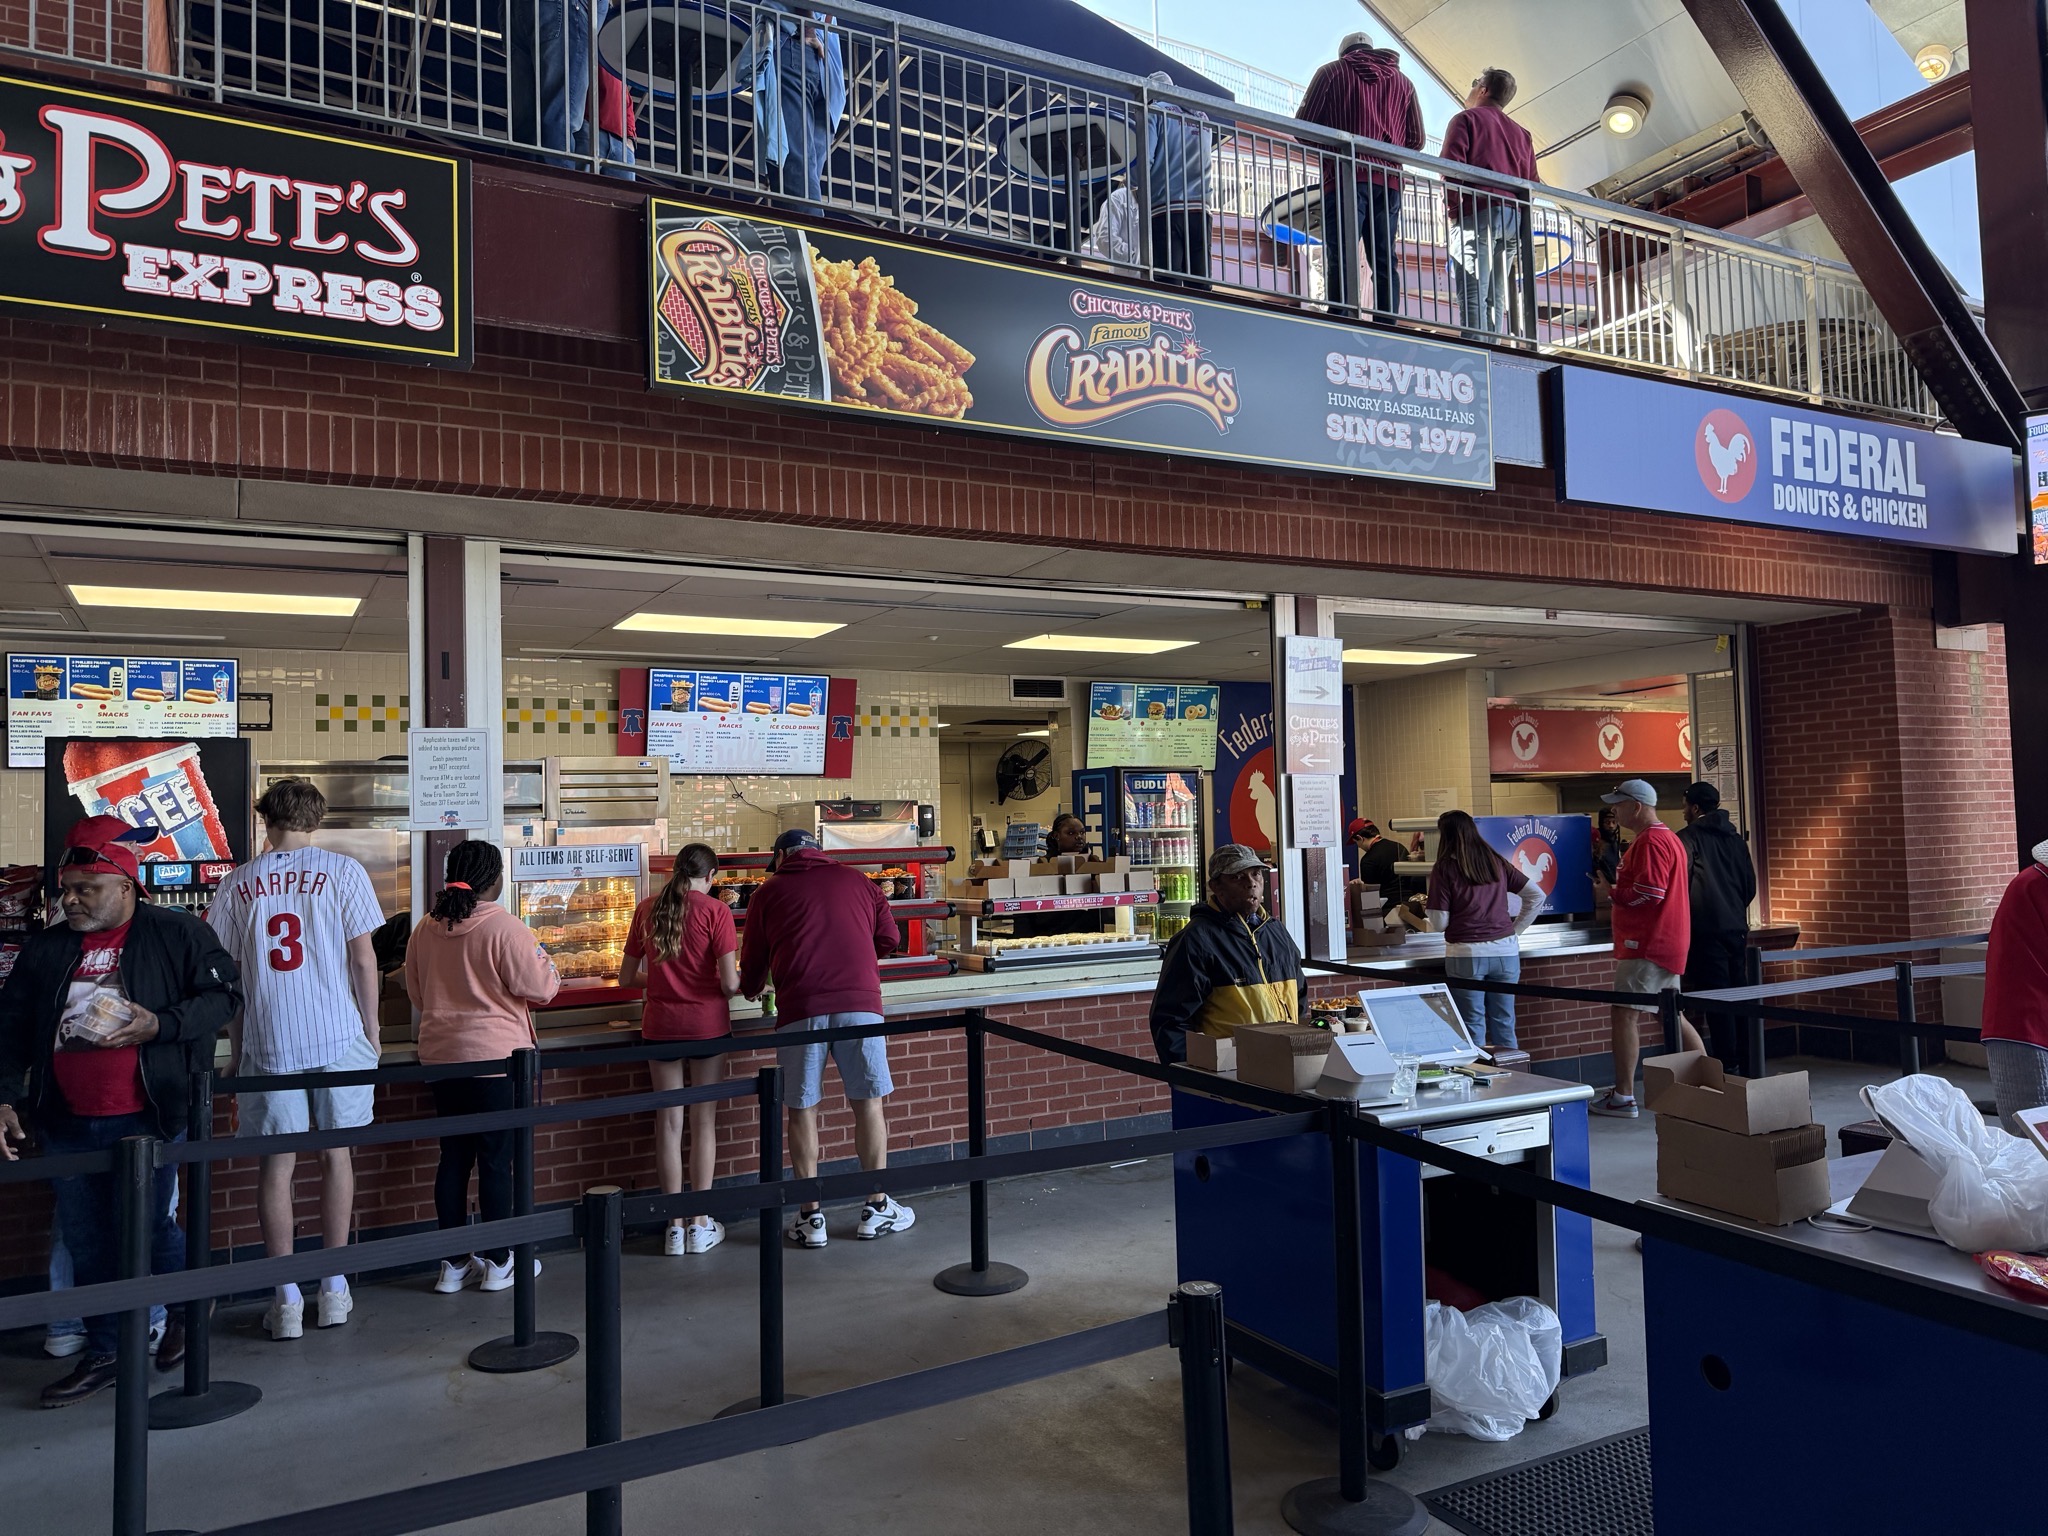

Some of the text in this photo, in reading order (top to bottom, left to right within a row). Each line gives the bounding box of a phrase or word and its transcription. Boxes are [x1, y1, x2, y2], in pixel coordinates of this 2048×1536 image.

[121, 241, 446, 332] EXPRESS
[749, 253, 775, 318] CHICKIE'S
[765, 327, 783, 365] PETE'S
[1073, 291, 1193, 333] CHICKIE'S & PETE'S
[1326, 351, 1475, 405] SERVING
[1327, 392, 1475, 425] HUNGRY BASEBALL FANS
[1326, 413, 1476, 458] SINCE 1977
[1770, 416, 1926, 498] FEDERAL
[1773, 482, 1927, 530] DONUTS & CHICKEN
[1289, 714, 1339, 730] CHICKIE'S
[1302, 729, 1339, 747] & PETE'S
[1134, 780, 1155, 790] BUD
[1506, 819, 1559, 846] Federal Donuts
[520, 848, 634, 866] ALL ITEMS ARE SELF-SERVE
[237, 869, 328, 906] HARPER
[266, 912, 305, 973] 3
